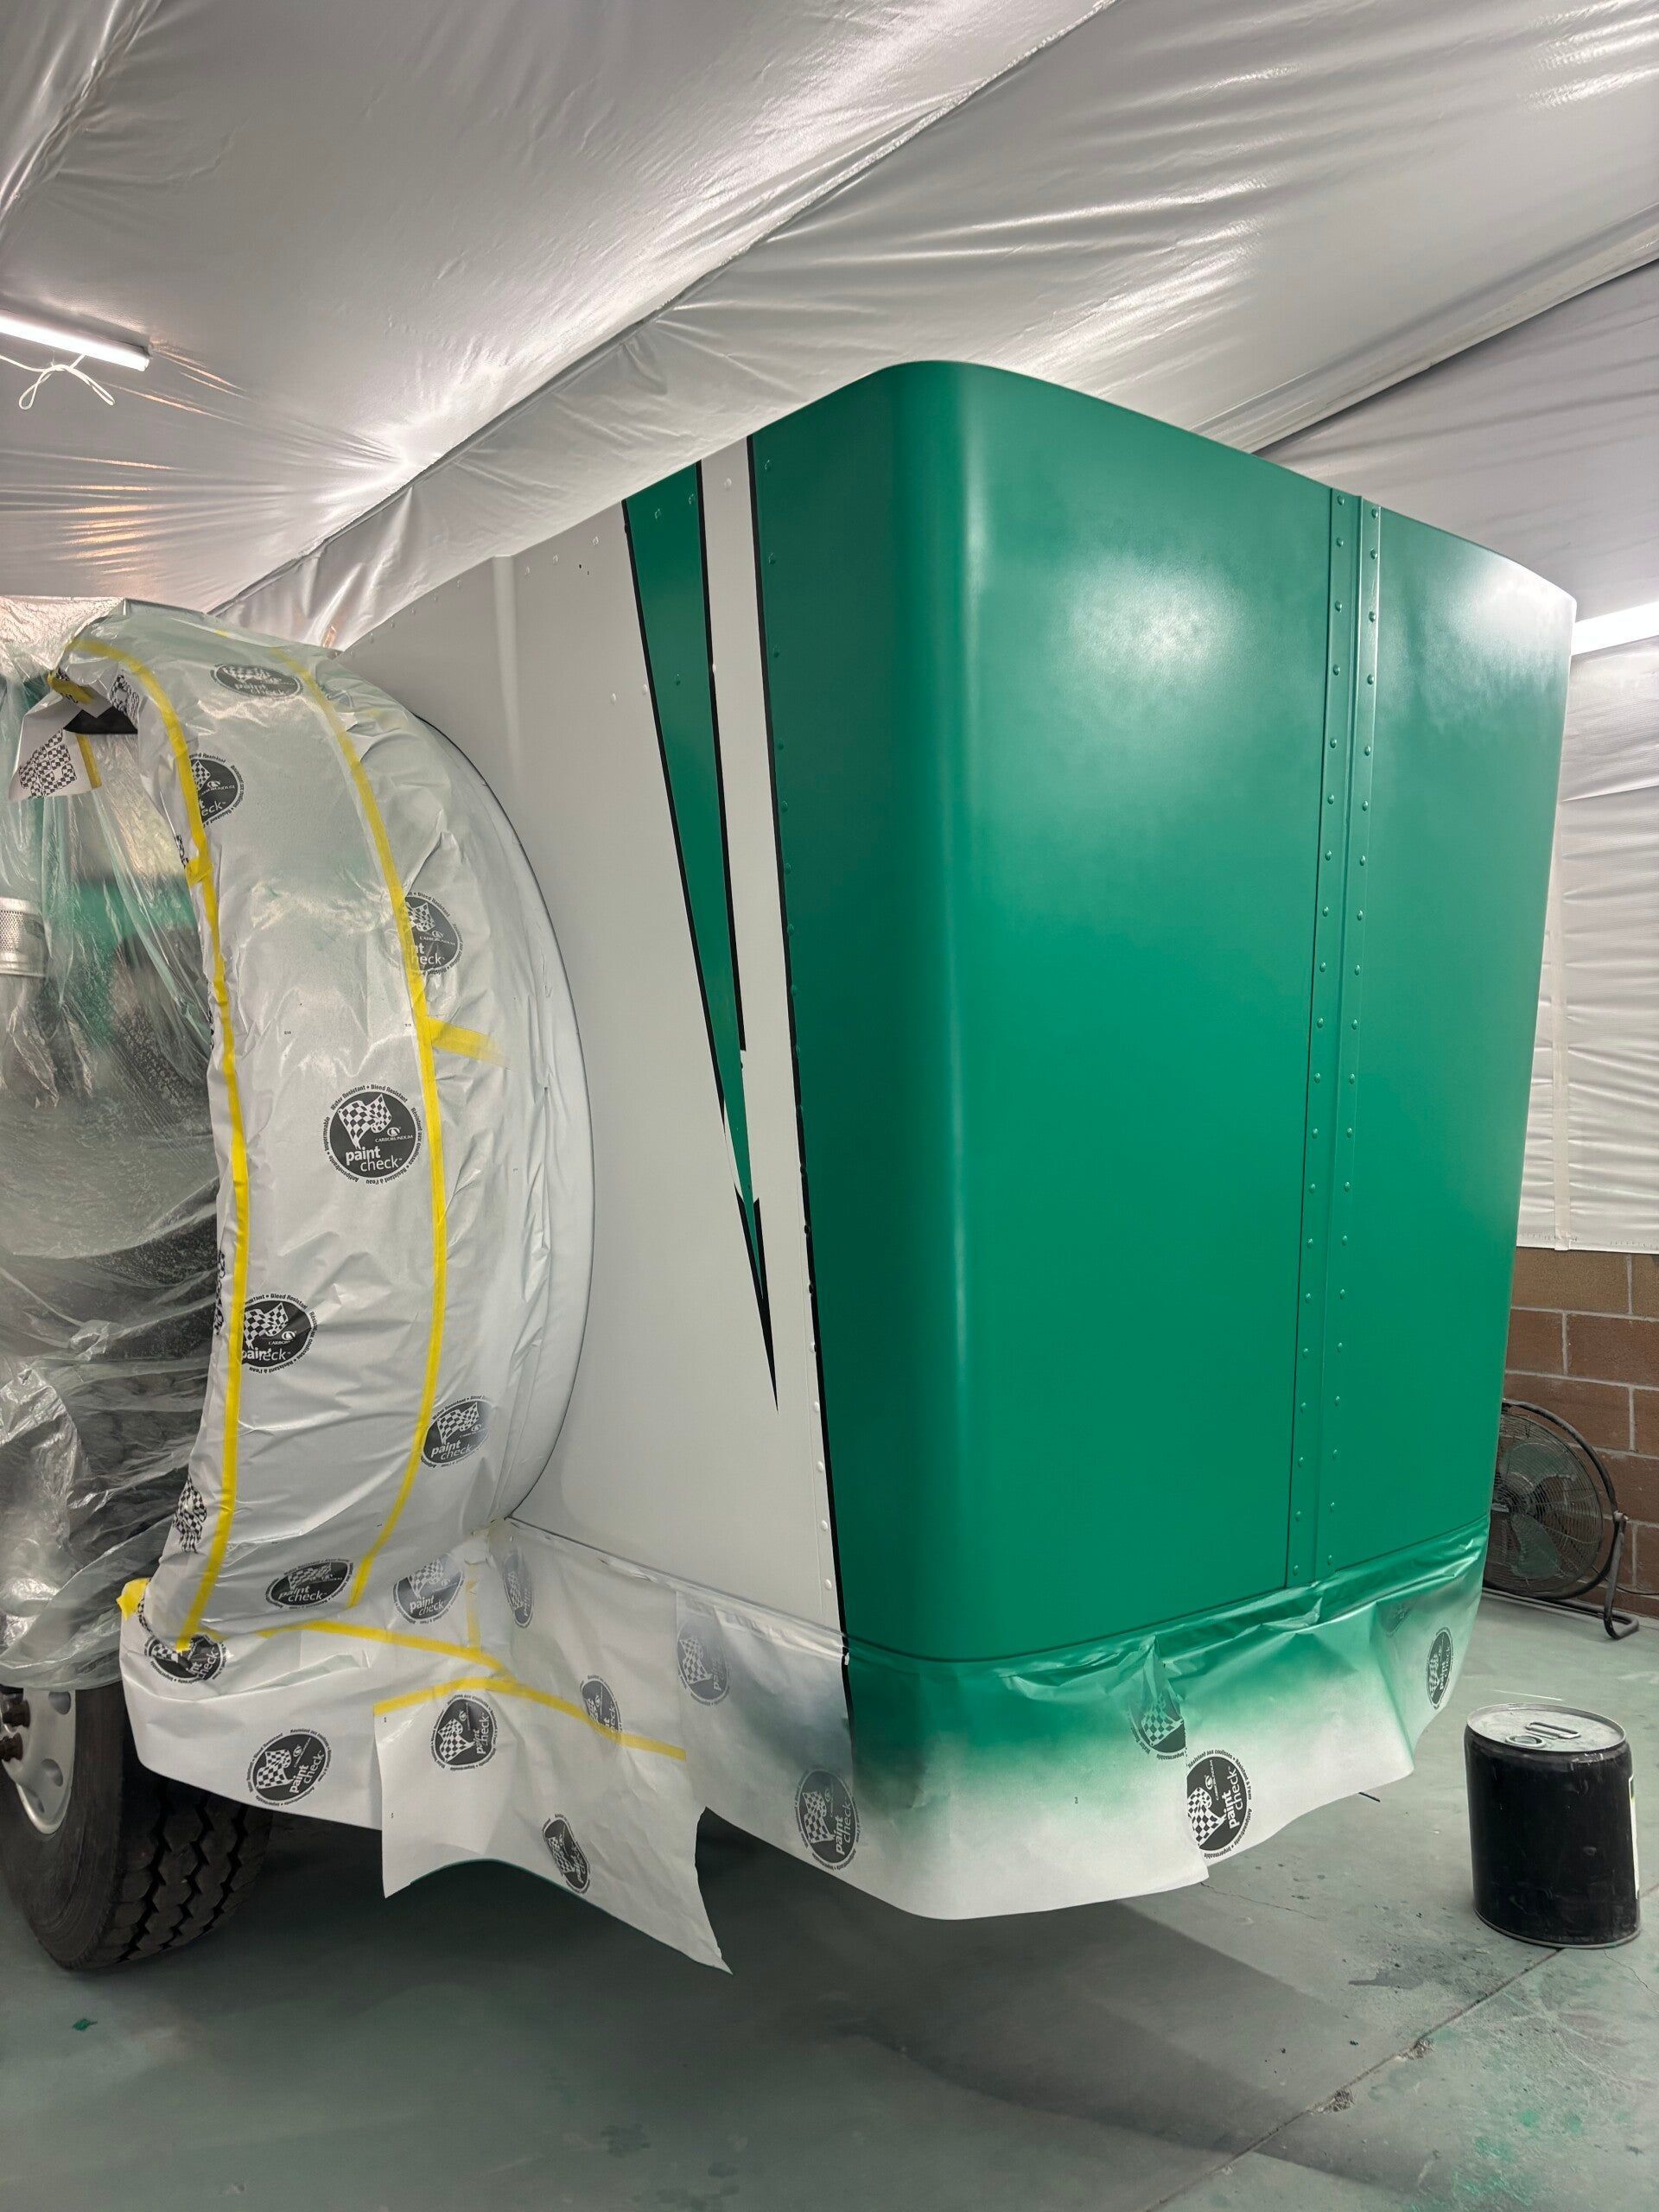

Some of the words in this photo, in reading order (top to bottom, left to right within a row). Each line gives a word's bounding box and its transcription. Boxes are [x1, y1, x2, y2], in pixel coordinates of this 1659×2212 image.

[201, 800, 223, 816] eck
[420, 952, 442, 966] eck
[346, 1146, 381, 1166] paint
[360, 1154, 399, 1172] check
[430, 1440, 461, 1459] paint
[441, 1444, 472, 1460] check
[288, 1590, 322, 1602] check
[409, 1594, 435, 1615] paint
[303, 1752, 325, 1783] check
[289, 1764, 308, 1794] paint
[1227, 1768, 1243, 1810] check
[1221, 1789, 1240, 1829] paint
[842, 1801, 851, 1844] check
[836, 1815, 845, 1856] paint
